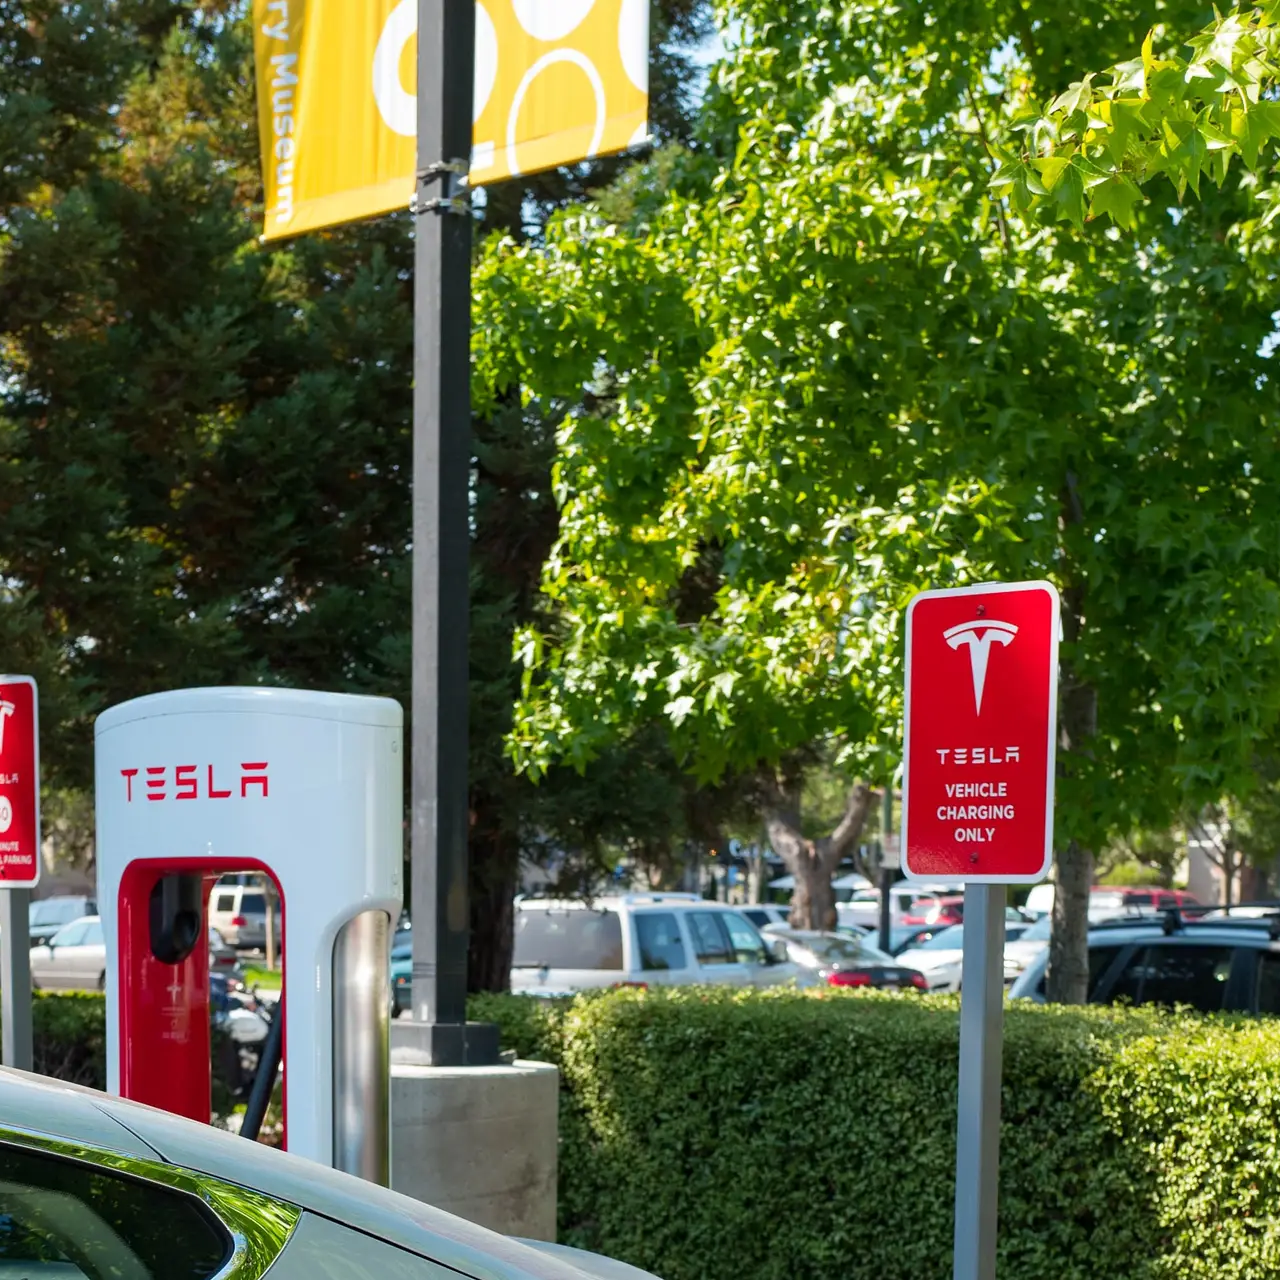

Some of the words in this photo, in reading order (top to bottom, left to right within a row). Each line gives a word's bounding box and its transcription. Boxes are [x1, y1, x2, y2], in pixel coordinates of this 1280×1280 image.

[270, 52, 299, 223] Museum
[936, 746, 1020, 765] TESLA
[120, 762, 269, 802] TESLA
[945, 782, 1008, 798] VEHICLE
[937, 804, 1015, 821] CHARGING
[954, 828, 996, 843] ONLY
